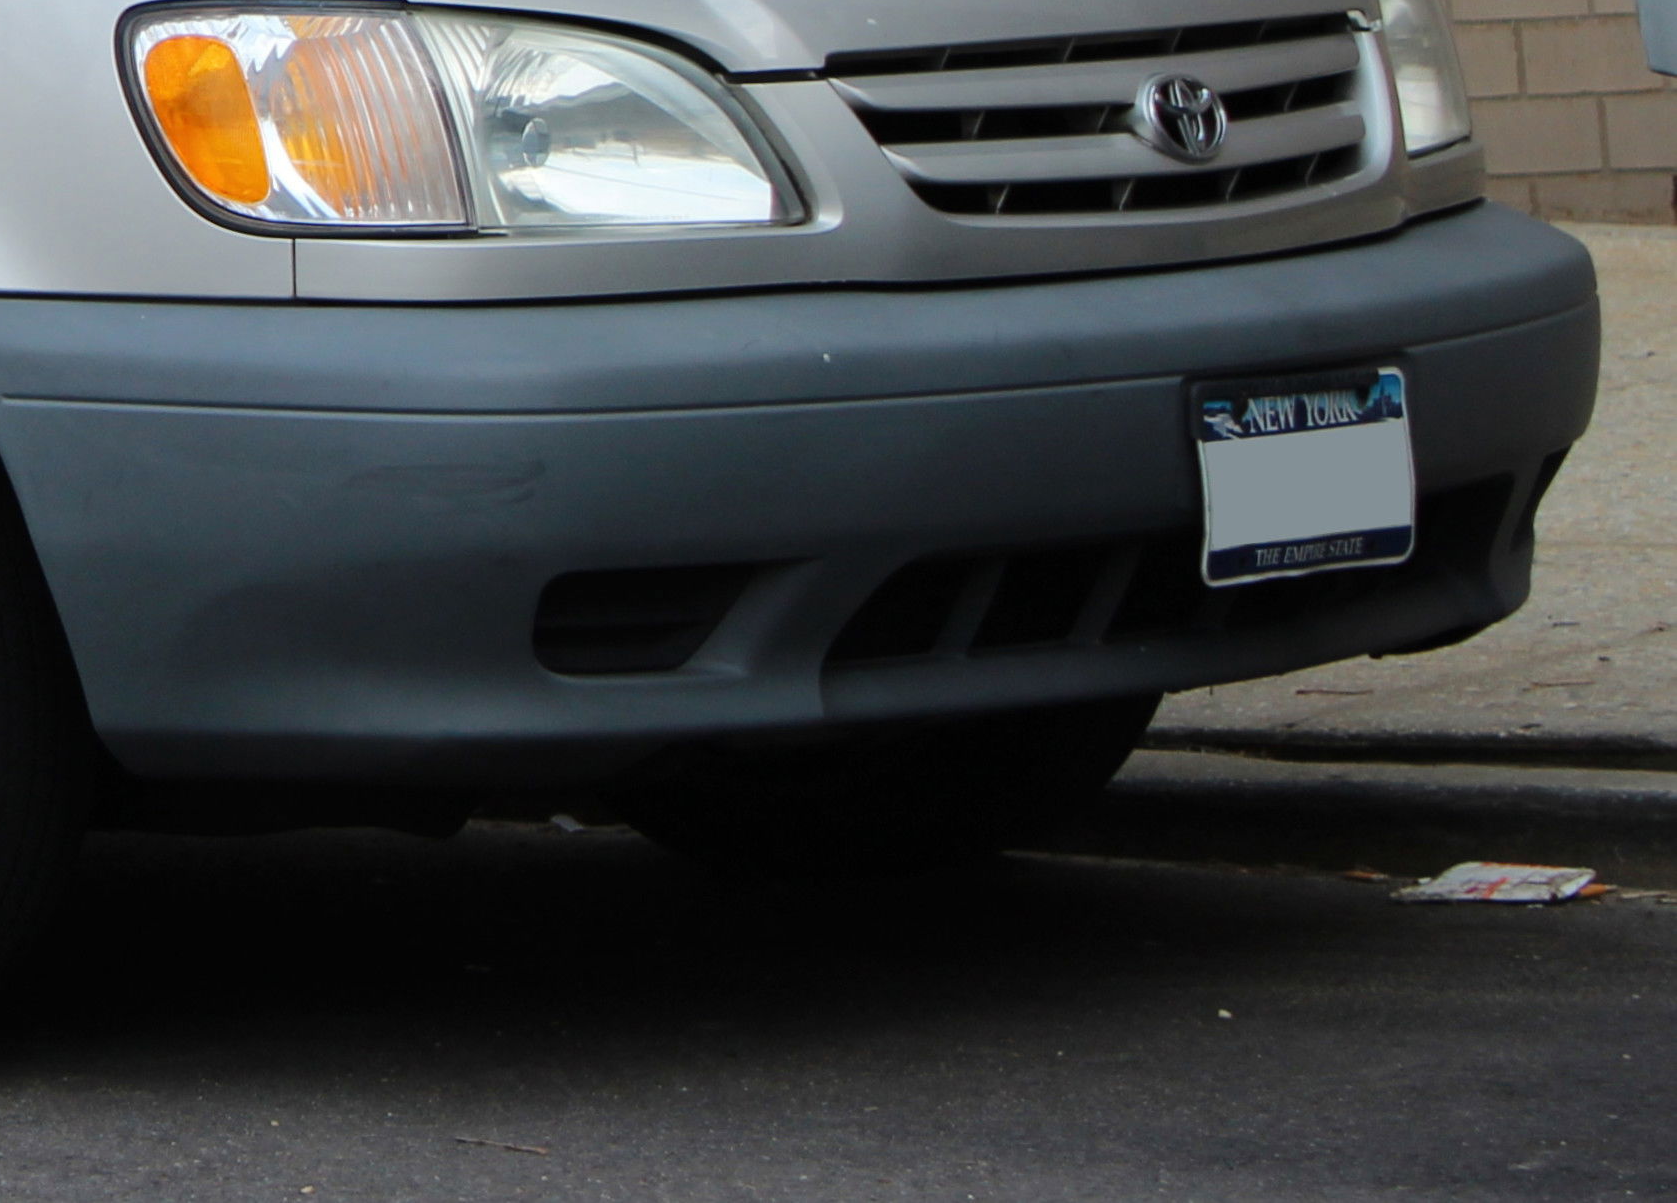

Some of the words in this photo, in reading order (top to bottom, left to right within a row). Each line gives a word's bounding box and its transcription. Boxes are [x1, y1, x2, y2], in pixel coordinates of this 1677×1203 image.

[1248, 395, 1296, 433] NEW
[1301, 390, 1358, 427] YORK
[1255, 547, 1282, 567] THE
[1283, 542, 1327, 564] EMPIRE
[1328, 536, 1364, 558] STATE
